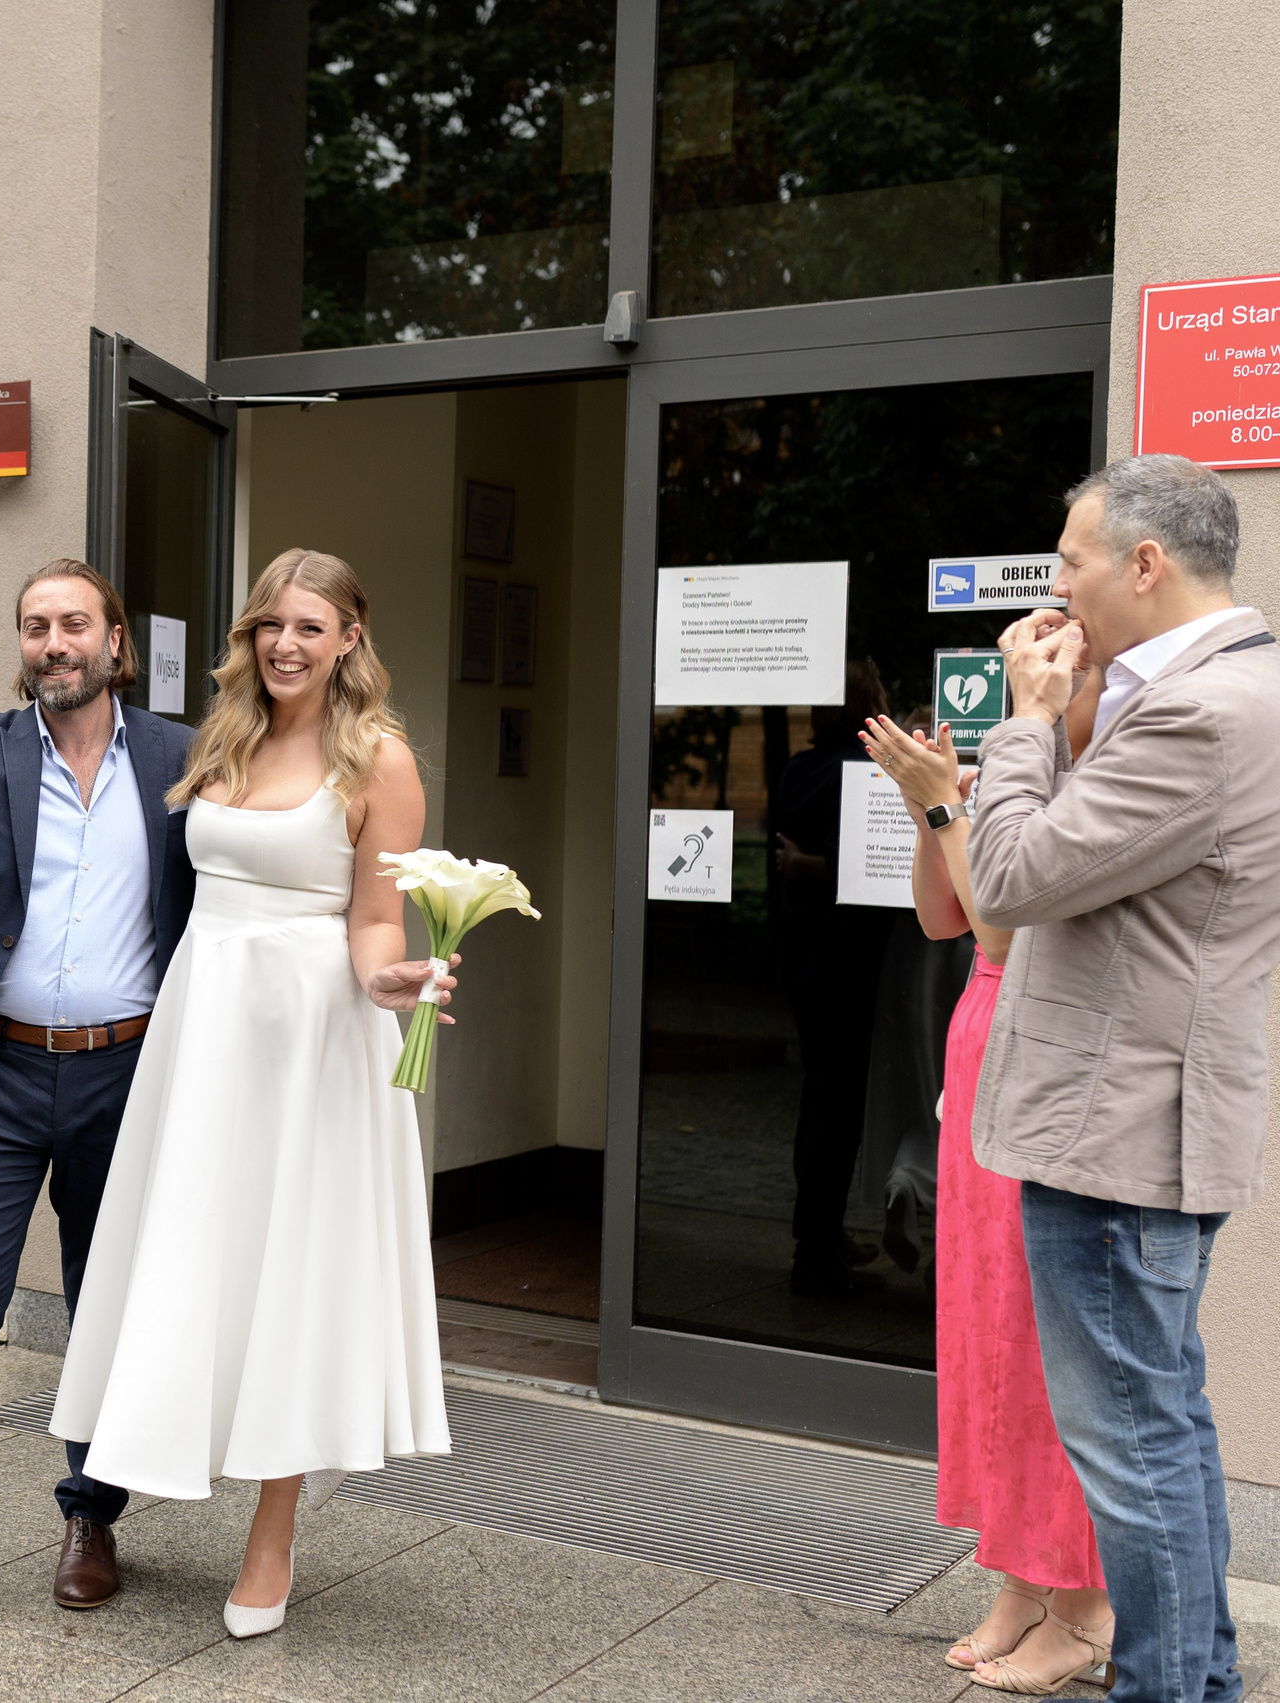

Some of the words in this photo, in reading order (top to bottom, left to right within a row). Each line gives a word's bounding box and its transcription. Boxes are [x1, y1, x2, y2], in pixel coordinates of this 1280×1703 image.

[1158, 307, 1224, 332] Urząd
[1204, 349, 1220, 362] ul.
[1225, 346, 1266, 361] Pawła
[1232, 362, 1280, 378] 50-072
[1192, 403, 1280, 427] poniedzia
[1001, 565, 1052, 581] OBIEKT
[979, 585, 1053, 599] MONITOROW
[682, 601, 700, 609] Drodzy
[785, 617, 808, 625] prosimy
[156, 652, 179, 684] Wyjście
[950, 729, 986, 738] FIBRYLAT
[664, 885, 680, 895] Pętla
[681, 885, 716, 896] indukcyjna
